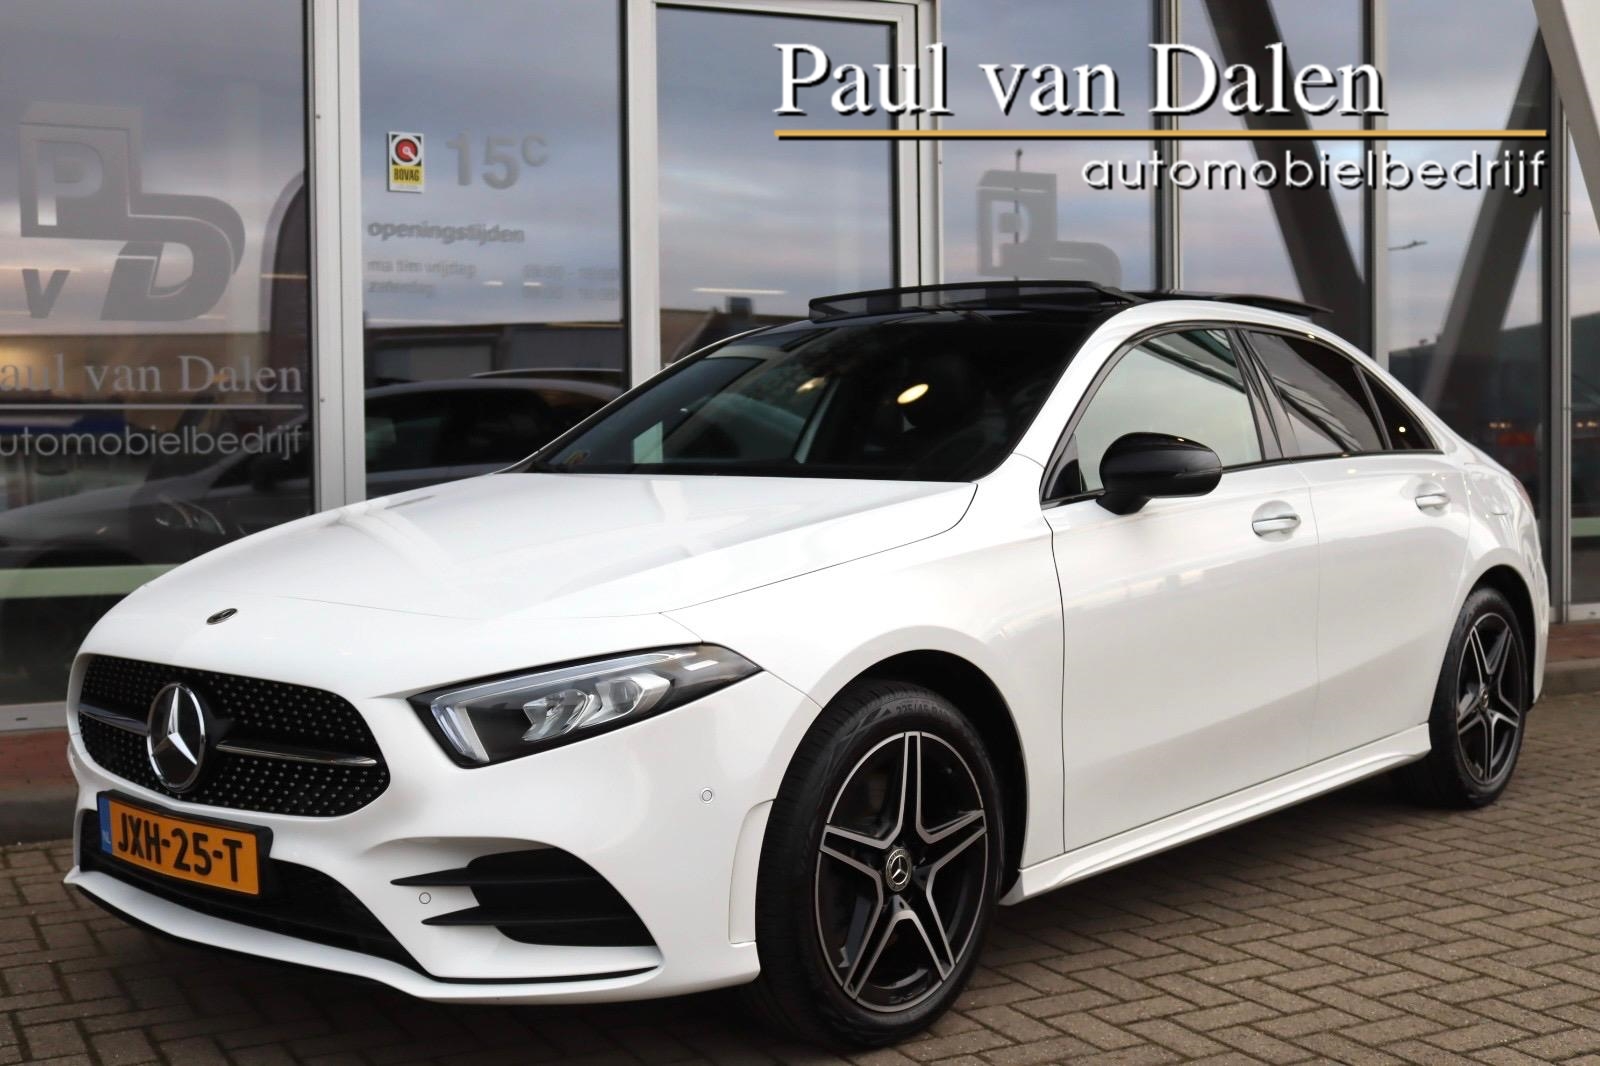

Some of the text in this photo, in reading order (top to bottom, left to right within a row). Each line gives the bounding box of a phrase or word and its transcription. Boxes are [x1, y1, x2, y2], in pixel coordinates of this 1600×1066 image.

[393, 168, 420, 182] BOVAG
[367, 220, 526, 246] openingstijden
[0, 352, 304, 393] aul van Dalen
[0, 425, 304, 461] utomobielbedrijf
[117, 812, 244, 883] JXH-25-T
